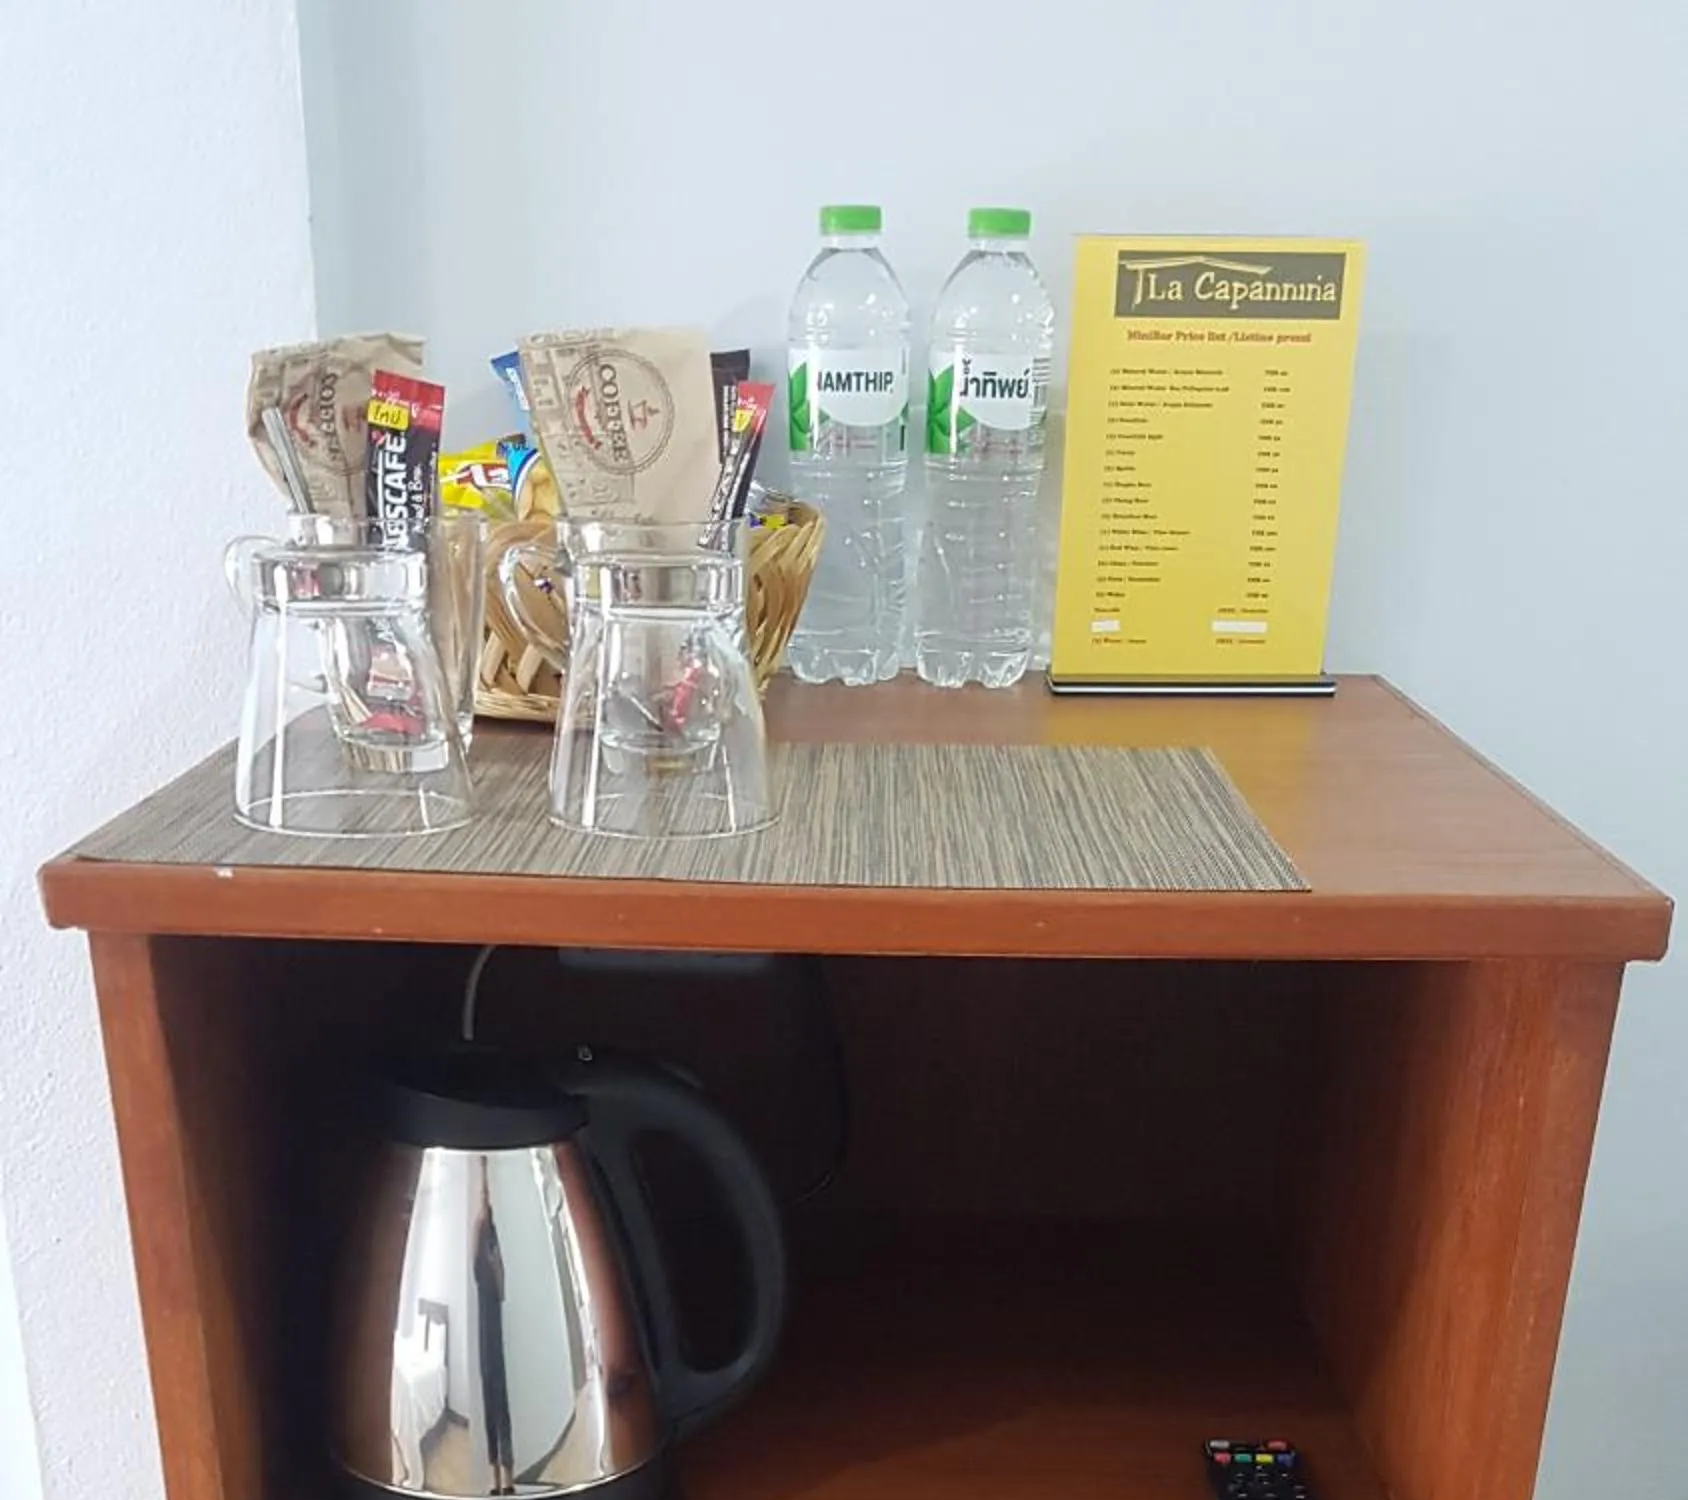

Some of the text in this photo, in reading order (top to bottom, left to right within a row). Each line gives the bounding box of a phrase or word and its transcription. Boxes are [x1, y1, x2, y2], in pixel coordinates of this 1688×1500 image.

[1148, 272, 1184, 302] La
[816, 371, 894, 393] AMTHIP
[599, 363, 631, 462] COFFEE
